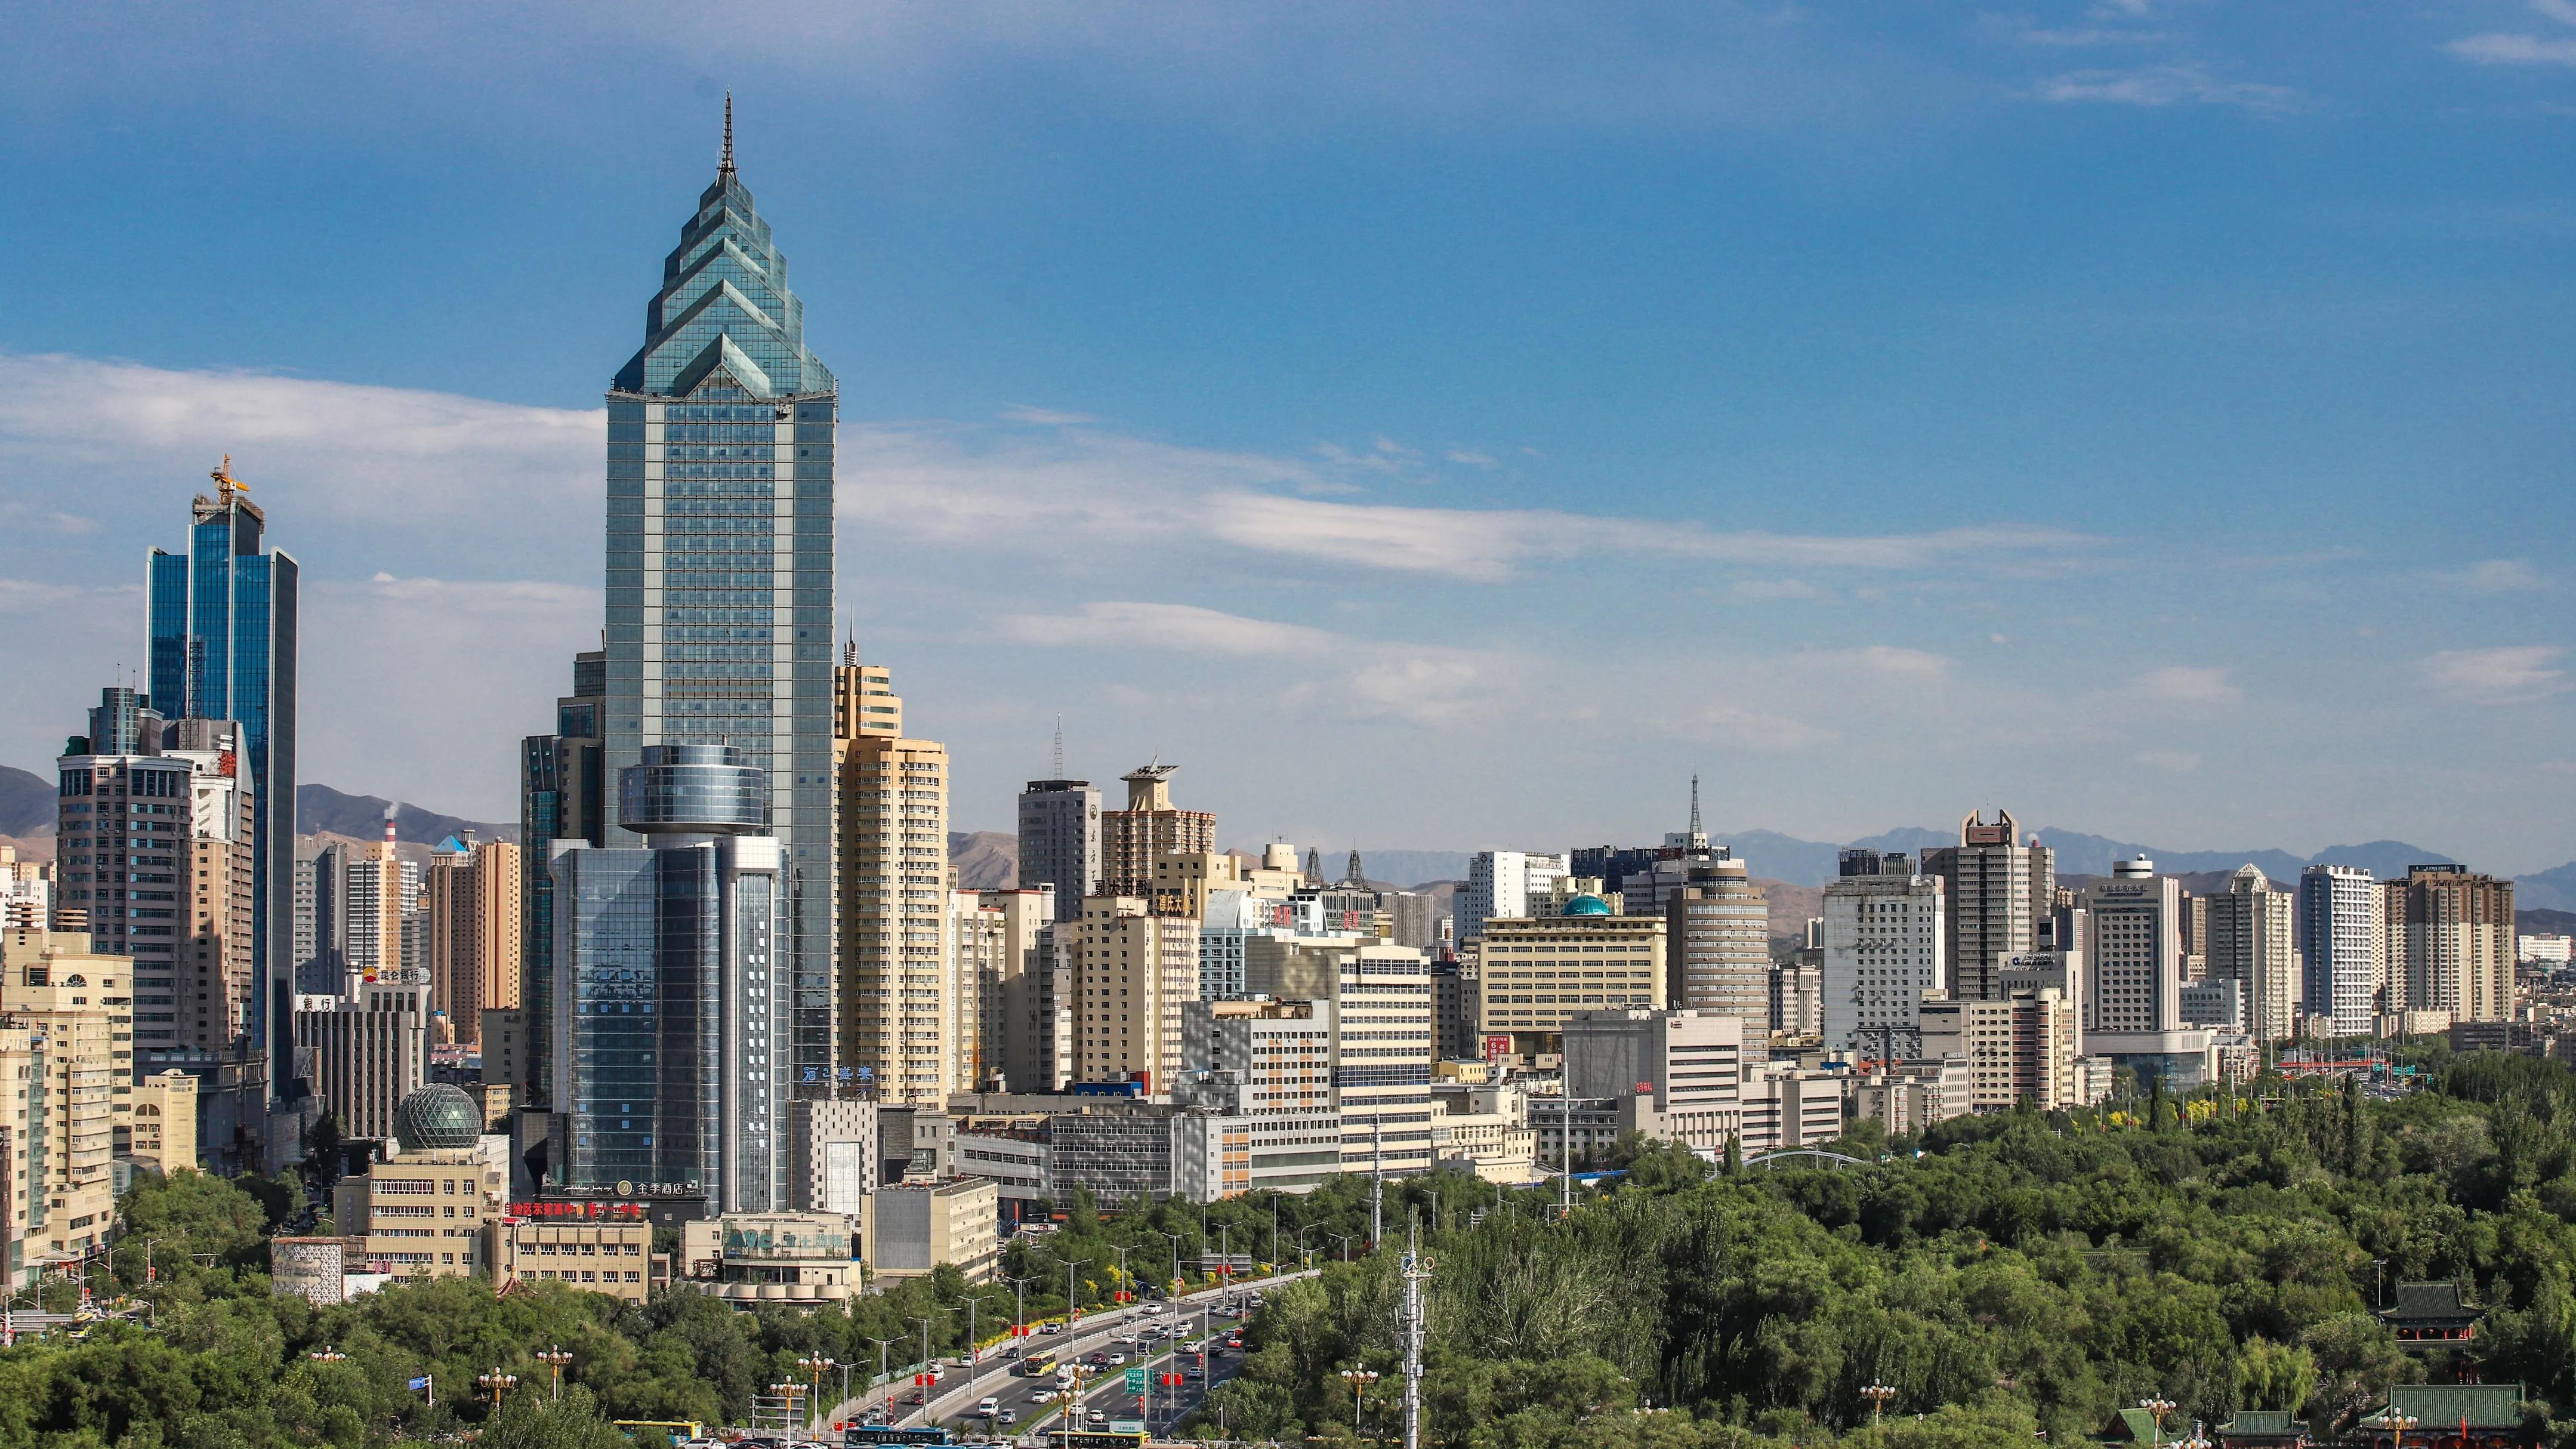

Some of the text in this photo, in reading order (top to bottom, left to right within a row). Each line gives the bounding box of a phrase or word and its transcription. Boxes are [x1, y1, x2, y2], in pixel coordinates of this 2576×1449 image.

[1159, 894, 1190, 914] 德氏大厦
[380, 970, 419, 981] 昆仑银行
[303, 998, 331, 1010] 银行
[637, 1182, 683, 1194] 全季酒店
